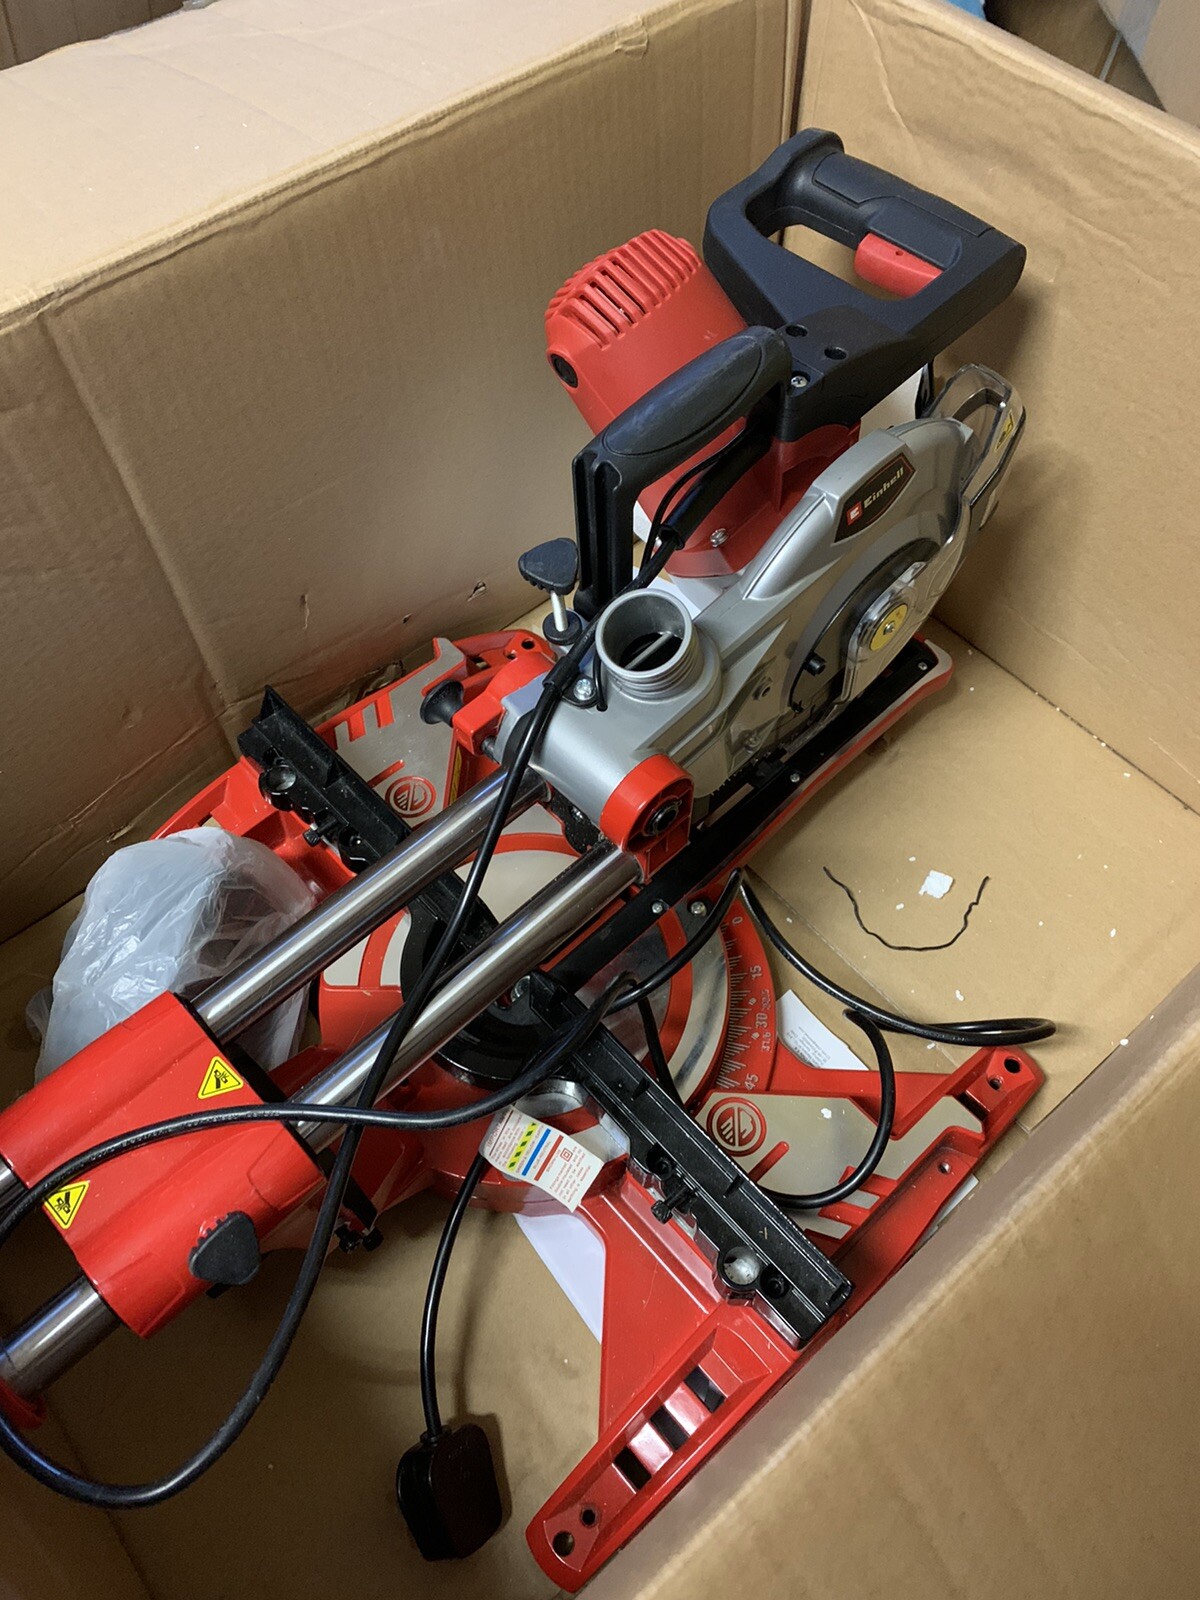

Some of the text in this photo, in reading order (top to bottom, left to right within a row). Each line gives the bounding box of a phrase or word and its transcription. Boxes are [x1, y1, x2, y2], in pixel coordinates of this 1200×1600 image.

[863, 467, 904, 509] Einhell
[732, 916, 744, 925] 0
[750, 964, 762, 980] 15
[756, 1012, 769, 1029] 30
[745, 1072, 759, 1091] 45
